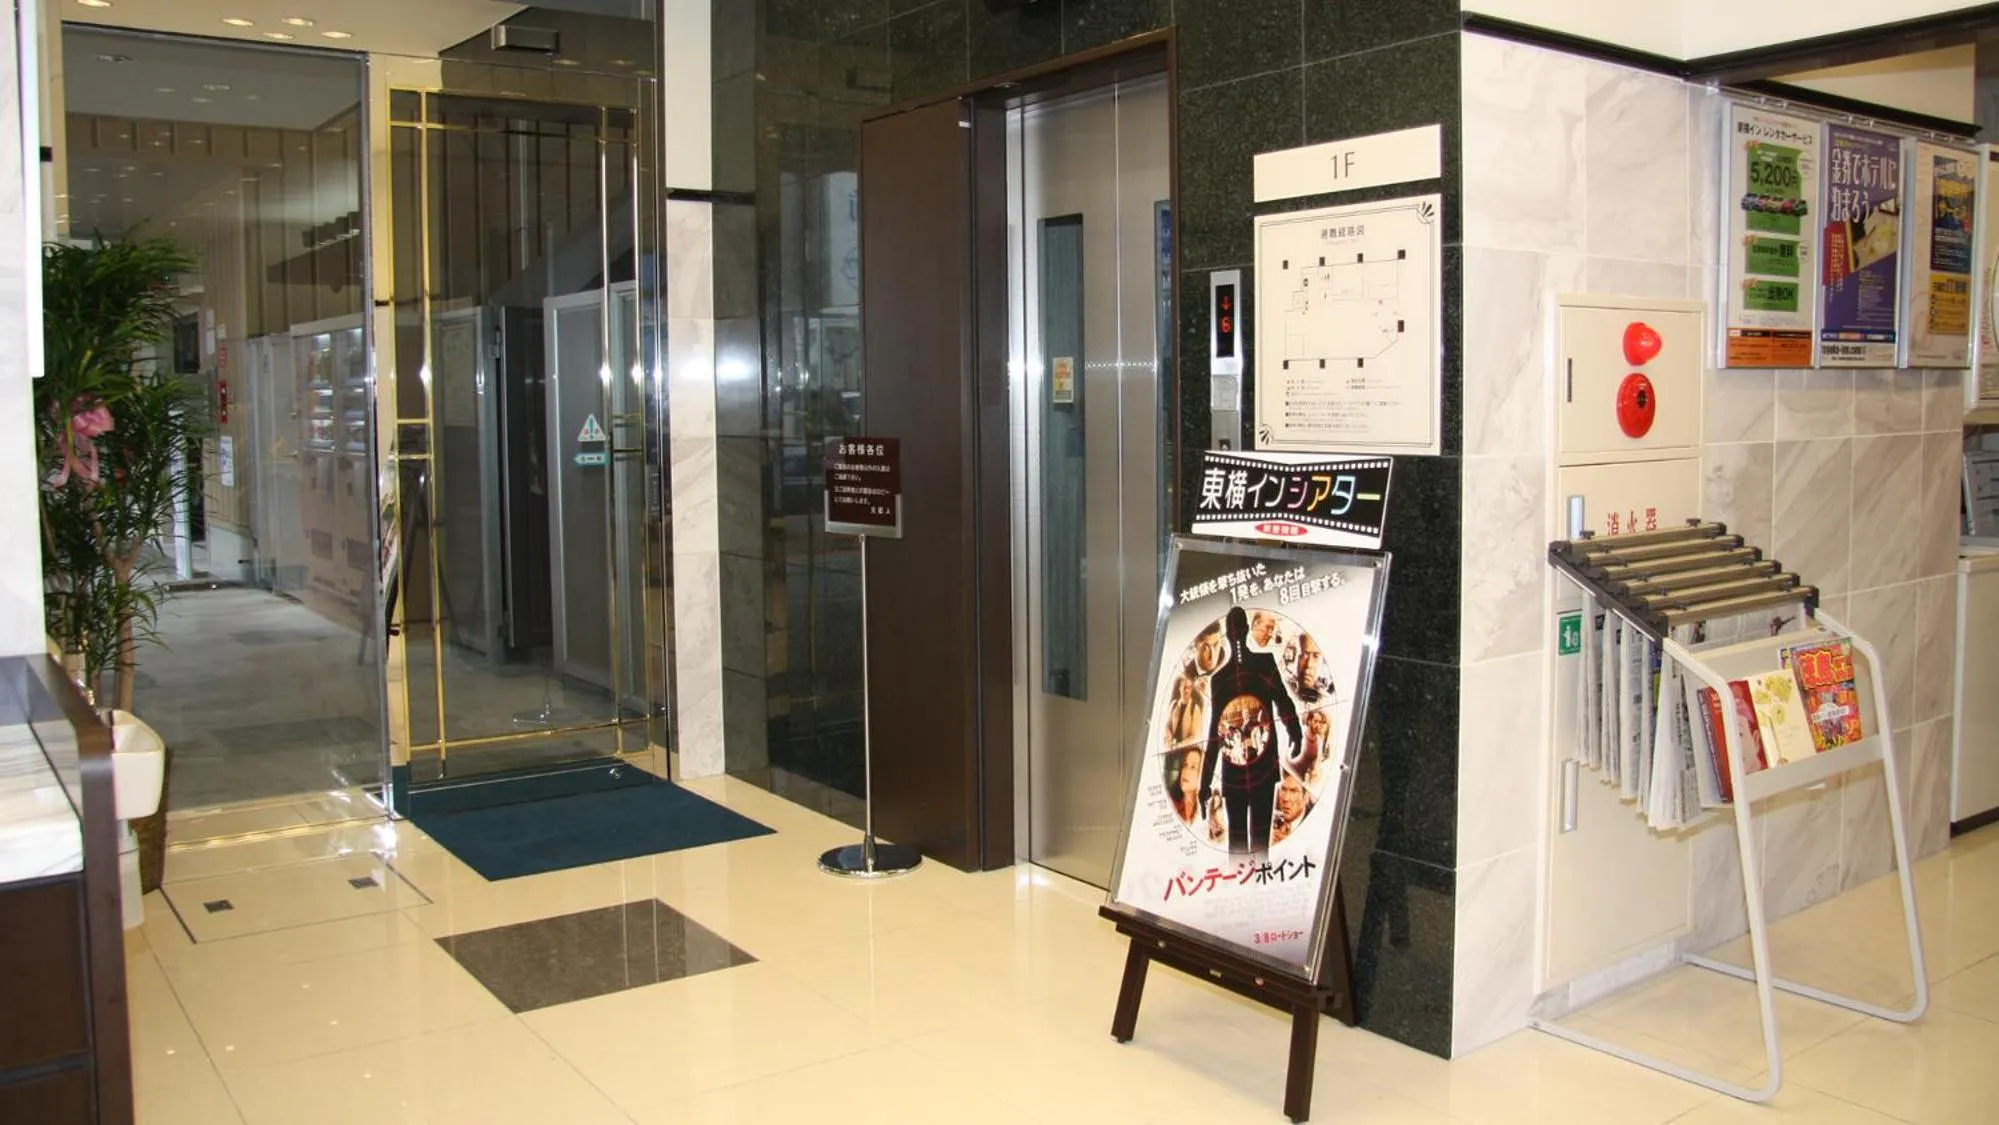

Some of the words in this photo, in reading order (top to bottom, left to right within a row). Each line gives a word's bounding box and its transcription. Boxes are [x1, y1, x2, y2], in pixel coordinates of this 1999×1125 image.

[1329, 150, 1358, 179] 1F
[1220, 317, 1232, 334] 6
[838, 443, 885, 457] お客様各位
[1199, 467, 1382, 516] 東横インシアター
[1606, 507, 1657, 537] 消火器
[1180, 562, 1267, 605] 大統領を撃ち抜いた
